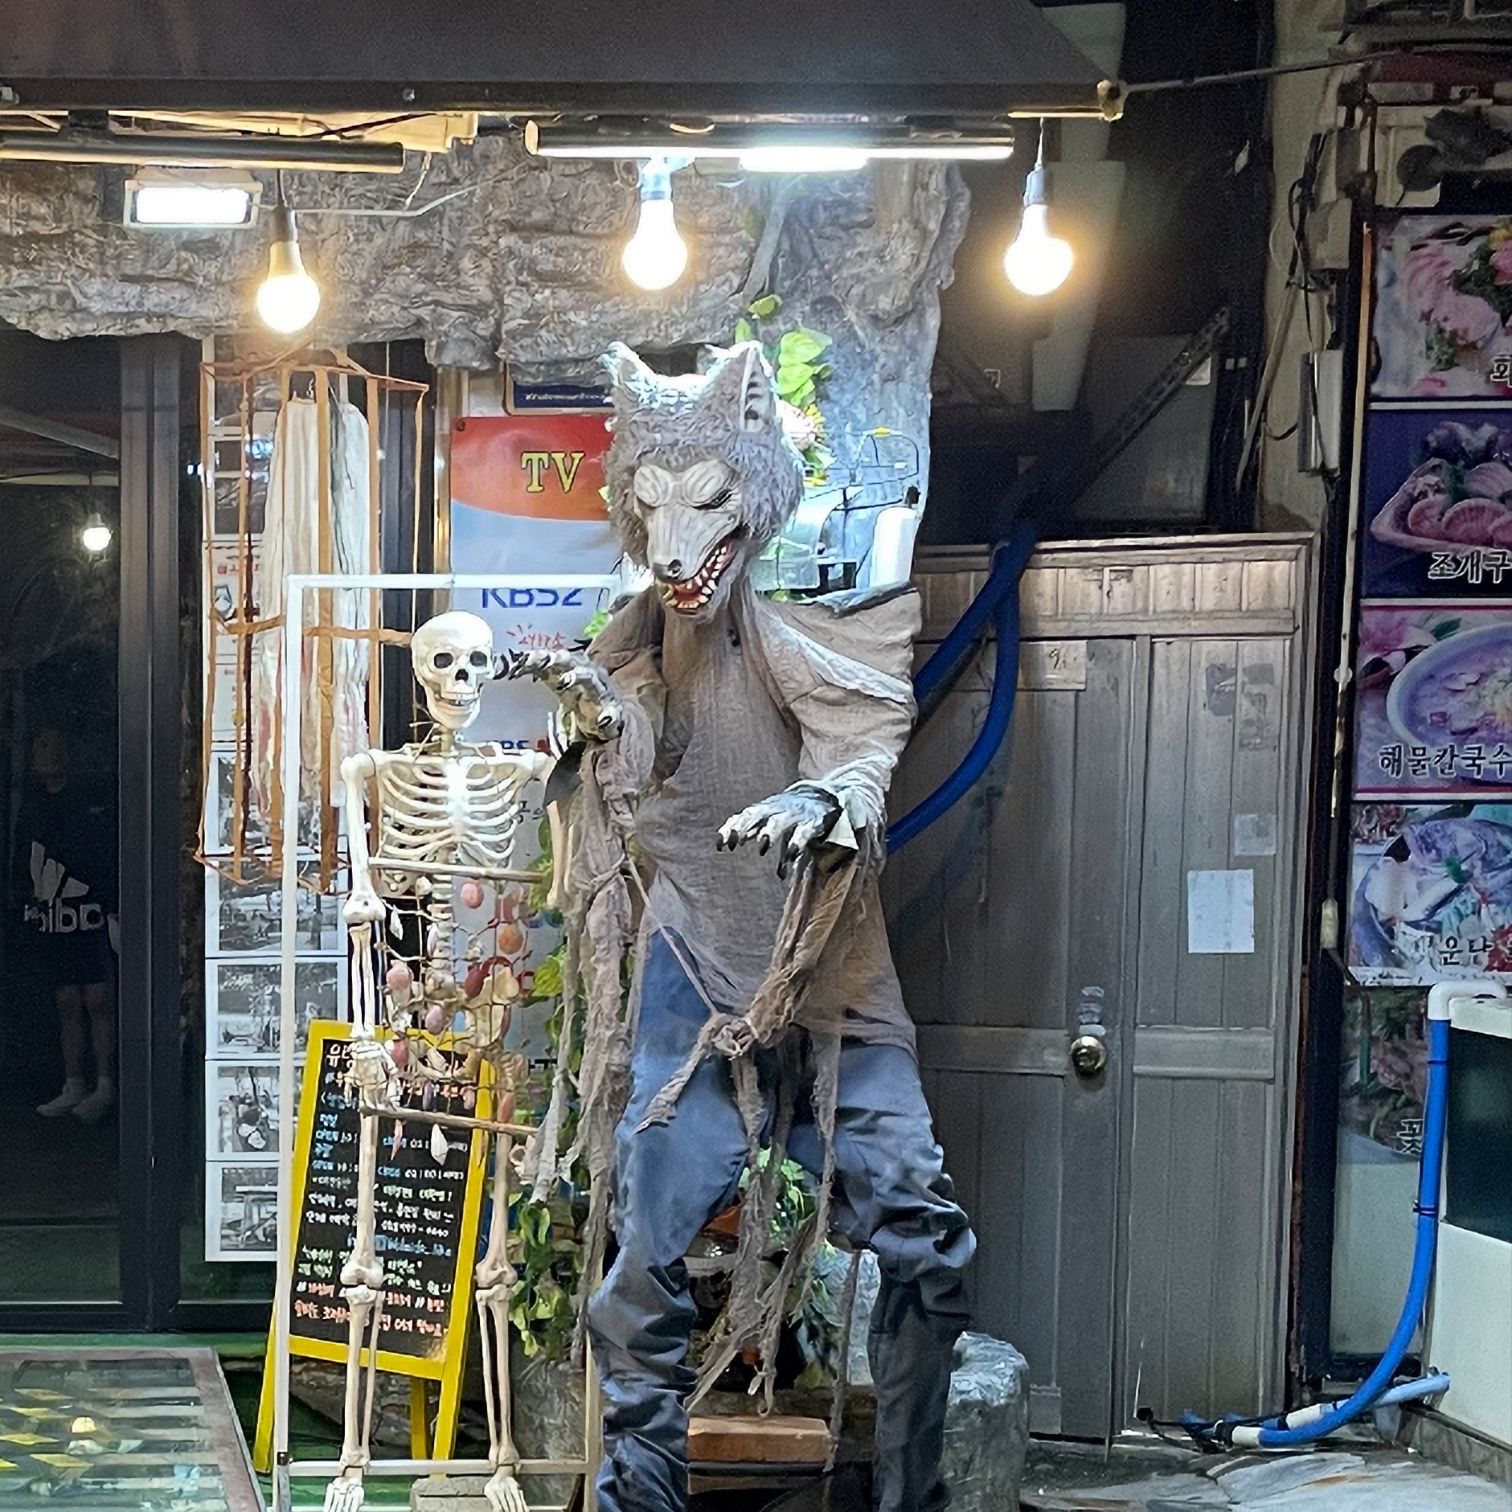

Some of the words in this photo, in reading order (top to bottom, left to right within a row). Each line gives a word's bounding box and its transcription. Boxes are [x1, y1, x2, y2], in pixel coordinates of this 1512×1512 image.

[521, 450, 586, 494] TV
[1427, 548, 1512, 584] 조개구
[1378, 742, 1512, 779] 해물칼국수
